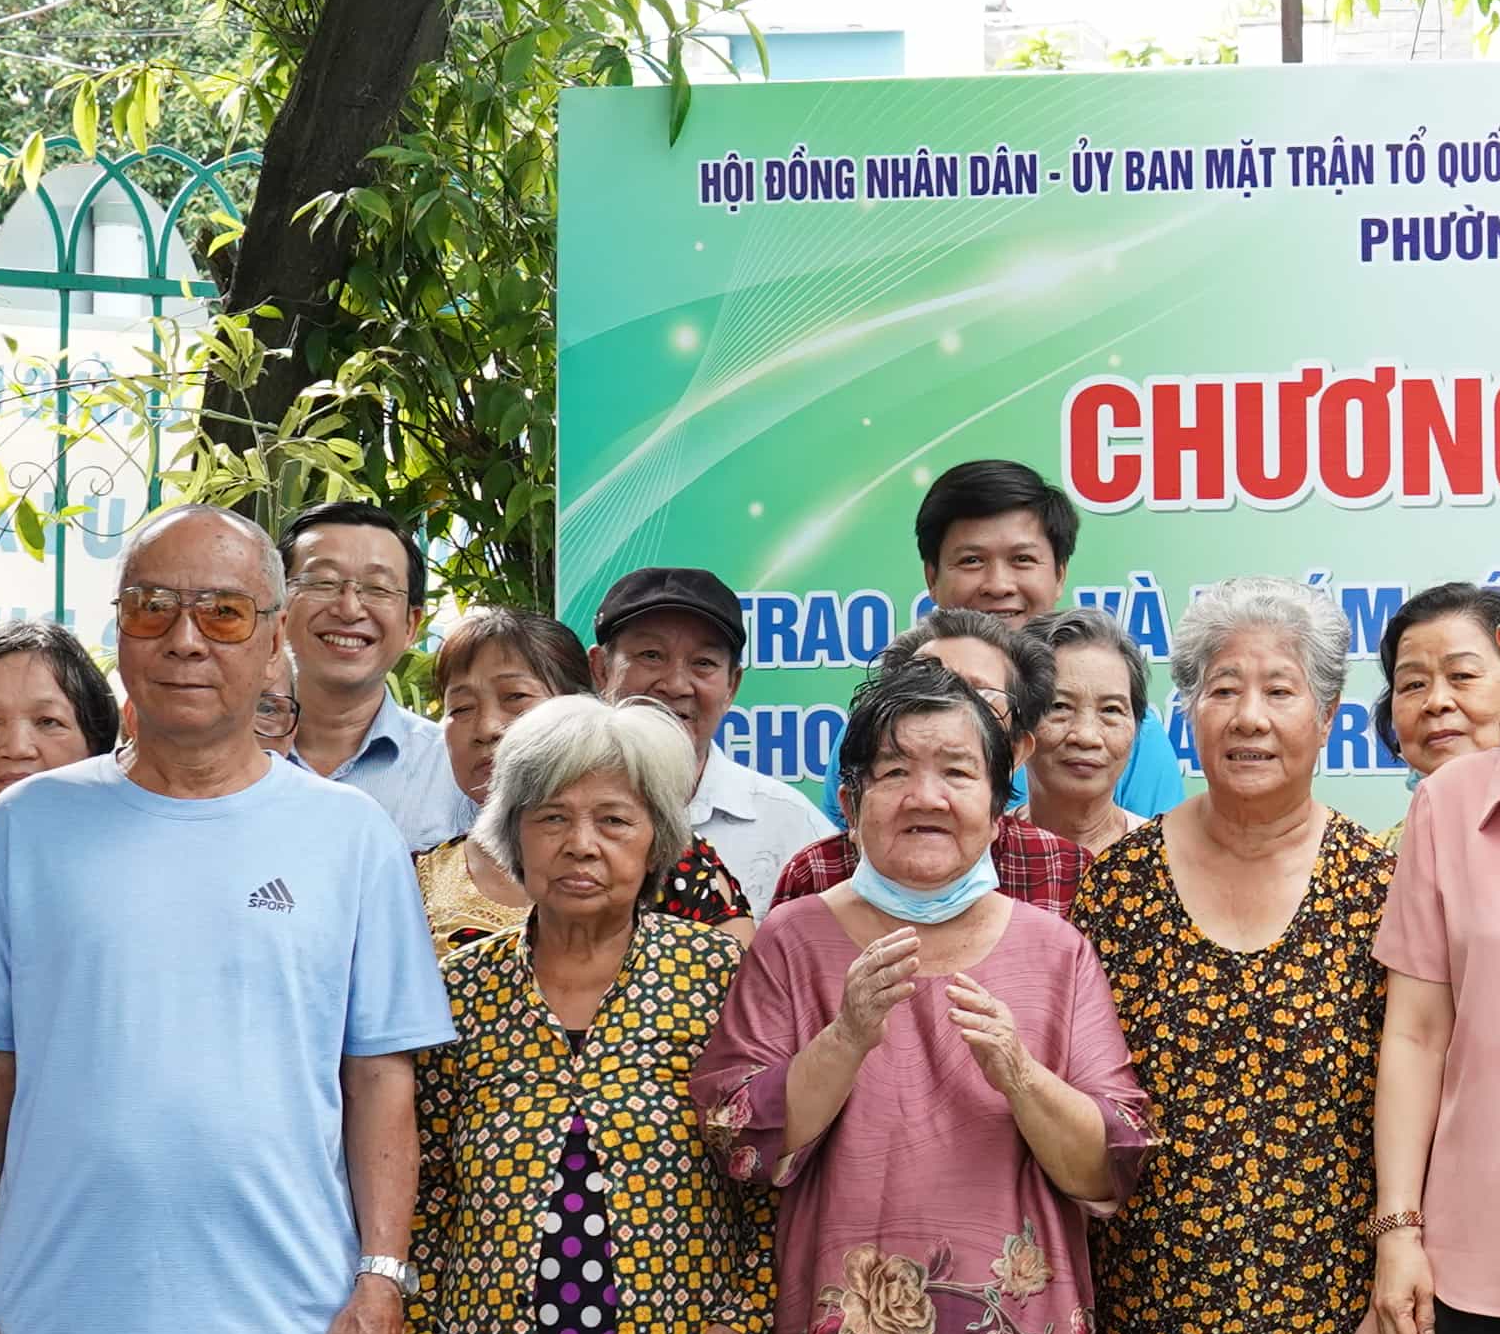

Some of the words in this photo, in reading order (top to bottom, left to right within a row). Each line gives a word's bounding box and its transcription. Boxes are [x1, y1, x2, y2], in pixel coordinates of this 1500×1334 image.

[700, 152, 754, 212] HỘI
[765, 144, 855, 202] ĐỒNG
[866, 147, 959, 199] NHÂN
[969, 145, 1038, 196] DÂN
[1072, 137, 1114, 193] ỦY
[1125, 149, 1194, 192] BAN
[1204, 139, 1276, 198] MẶT
[1287, 136, 1375, 195] TRẬN
[1385, 125, 1428, 184] TỔ
[247, 898, 296, 915] SPORT
